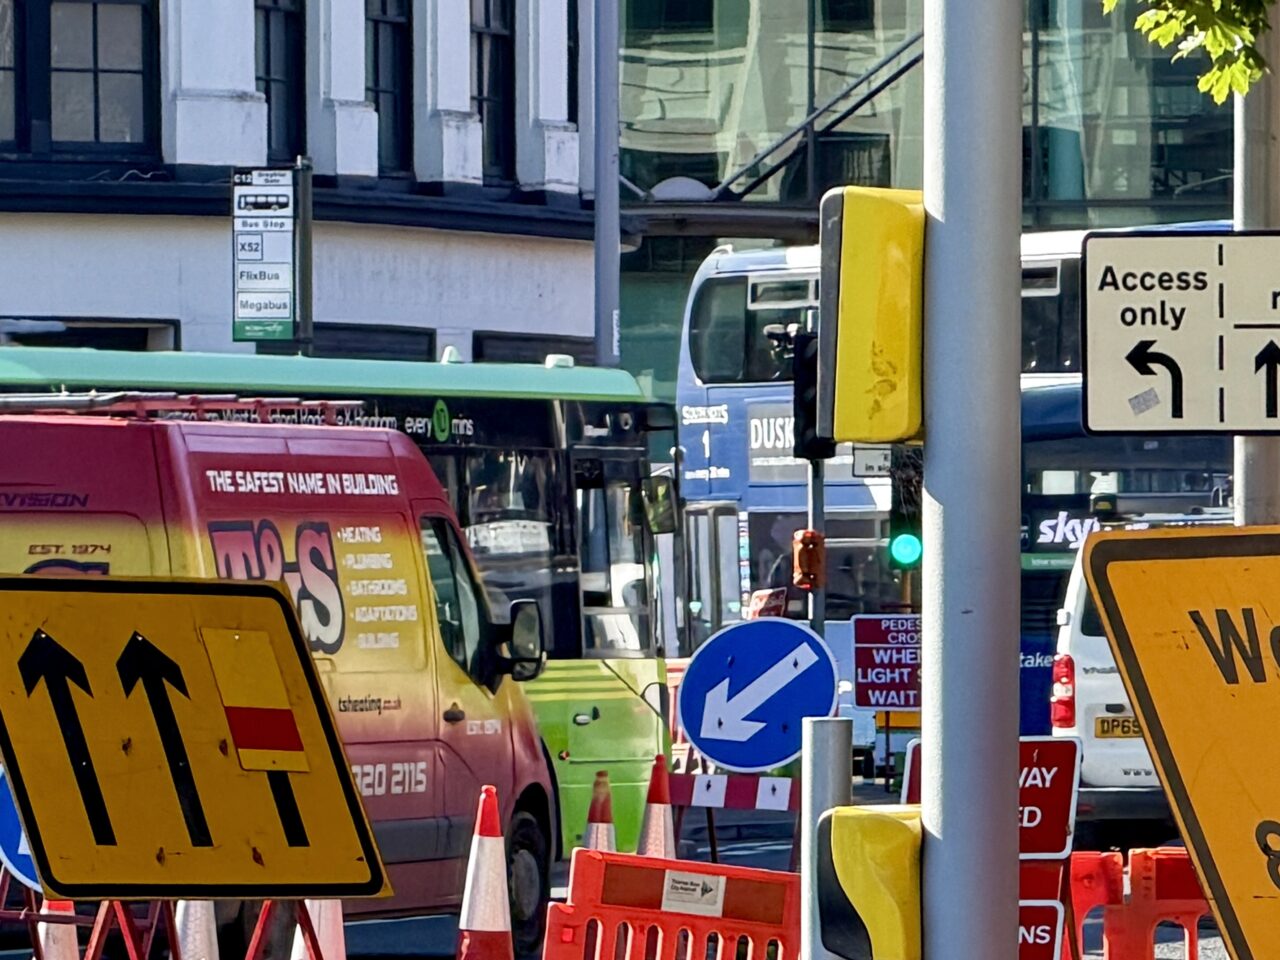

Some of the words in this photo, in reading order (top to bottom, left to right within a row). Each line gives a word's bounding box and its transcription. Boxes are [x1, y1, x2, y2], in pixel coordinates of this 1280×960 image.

[242, 220, 259, 228] Bus
[263, 220, 285, 229] Stop
[239, 242, 260, 252] X52
[239, 271, 280, 281] FlixBus
[1098, 265, 1208, 291] Access
[240, 300, 288, 312] Megabus
[1120, 301, 1186, 330] only
[404, 417, 431, 438] every
[451, 413, 474, 435] mins
[206, 470, 234, 492] THE
[235, 471, 284, 493] SAFEST
[287, 472, 325, 495] NAME
[328, 472, 341, 494] IN
[342, 473, 399, 495] BUILDING
[28, 544, 66, 555] EST.
[71, 544, 111, 554] 1974
[857, 668, 911, 683] LIGHT
[868, 690, 917, 705] WAIT
[391, 761, 427, 794] 2115
